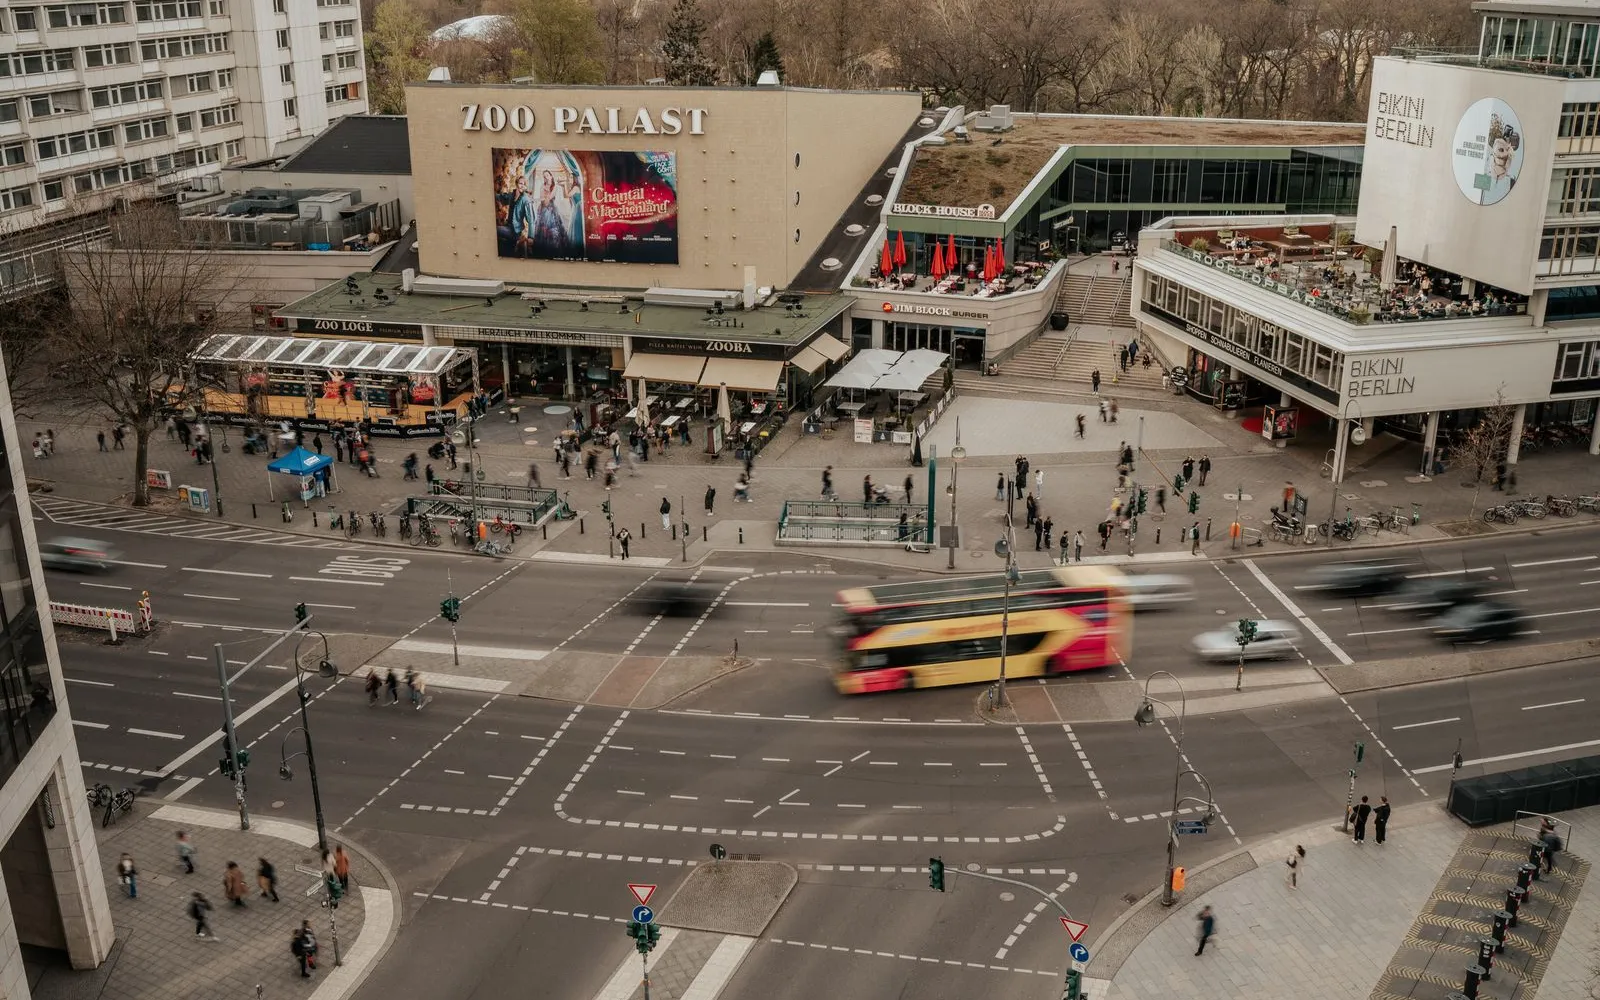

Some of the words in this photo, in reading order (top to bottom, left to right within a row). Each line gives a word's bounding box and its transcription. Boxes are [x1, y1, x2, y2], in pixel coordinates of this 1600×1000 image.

[1377, 91, 1425, 120] BIKINI
[460, 103, 536, 133] ZOO
[551, 105, 709, 136] PALAST
[1374, 116, 1435, 149] BERLIN
[592, 187, 645, 205] Chantal
[892, 203, 932, 214] BLOCK
[935, 205, 975, 217] HOUSE
[894, 304, 914, 313] JIM
[915, 305, 950, 316] BLOCK
[952, 310, 989, 319] BURGER
[314, 319, 339, 330] ZOO
[342, 321, 373, 332] LOGE
[477, 327, 521, 338] HERZLICH
[524, 330, 587, 341] WILLKOMMEN
[705, 341, 753, 353] ZOOBA
[1185, 323, 1207, 340] SHOPPEN
[1210, 335, 1251, 361] SCHNABULIEREN
[1253, 356, 1283, 376] FLANIEREN
[1350, 357, 1404, 377] BIKINI
[1348, 376, 1415, 398] BERLIN
[318, 555, 411, 579] BUS
